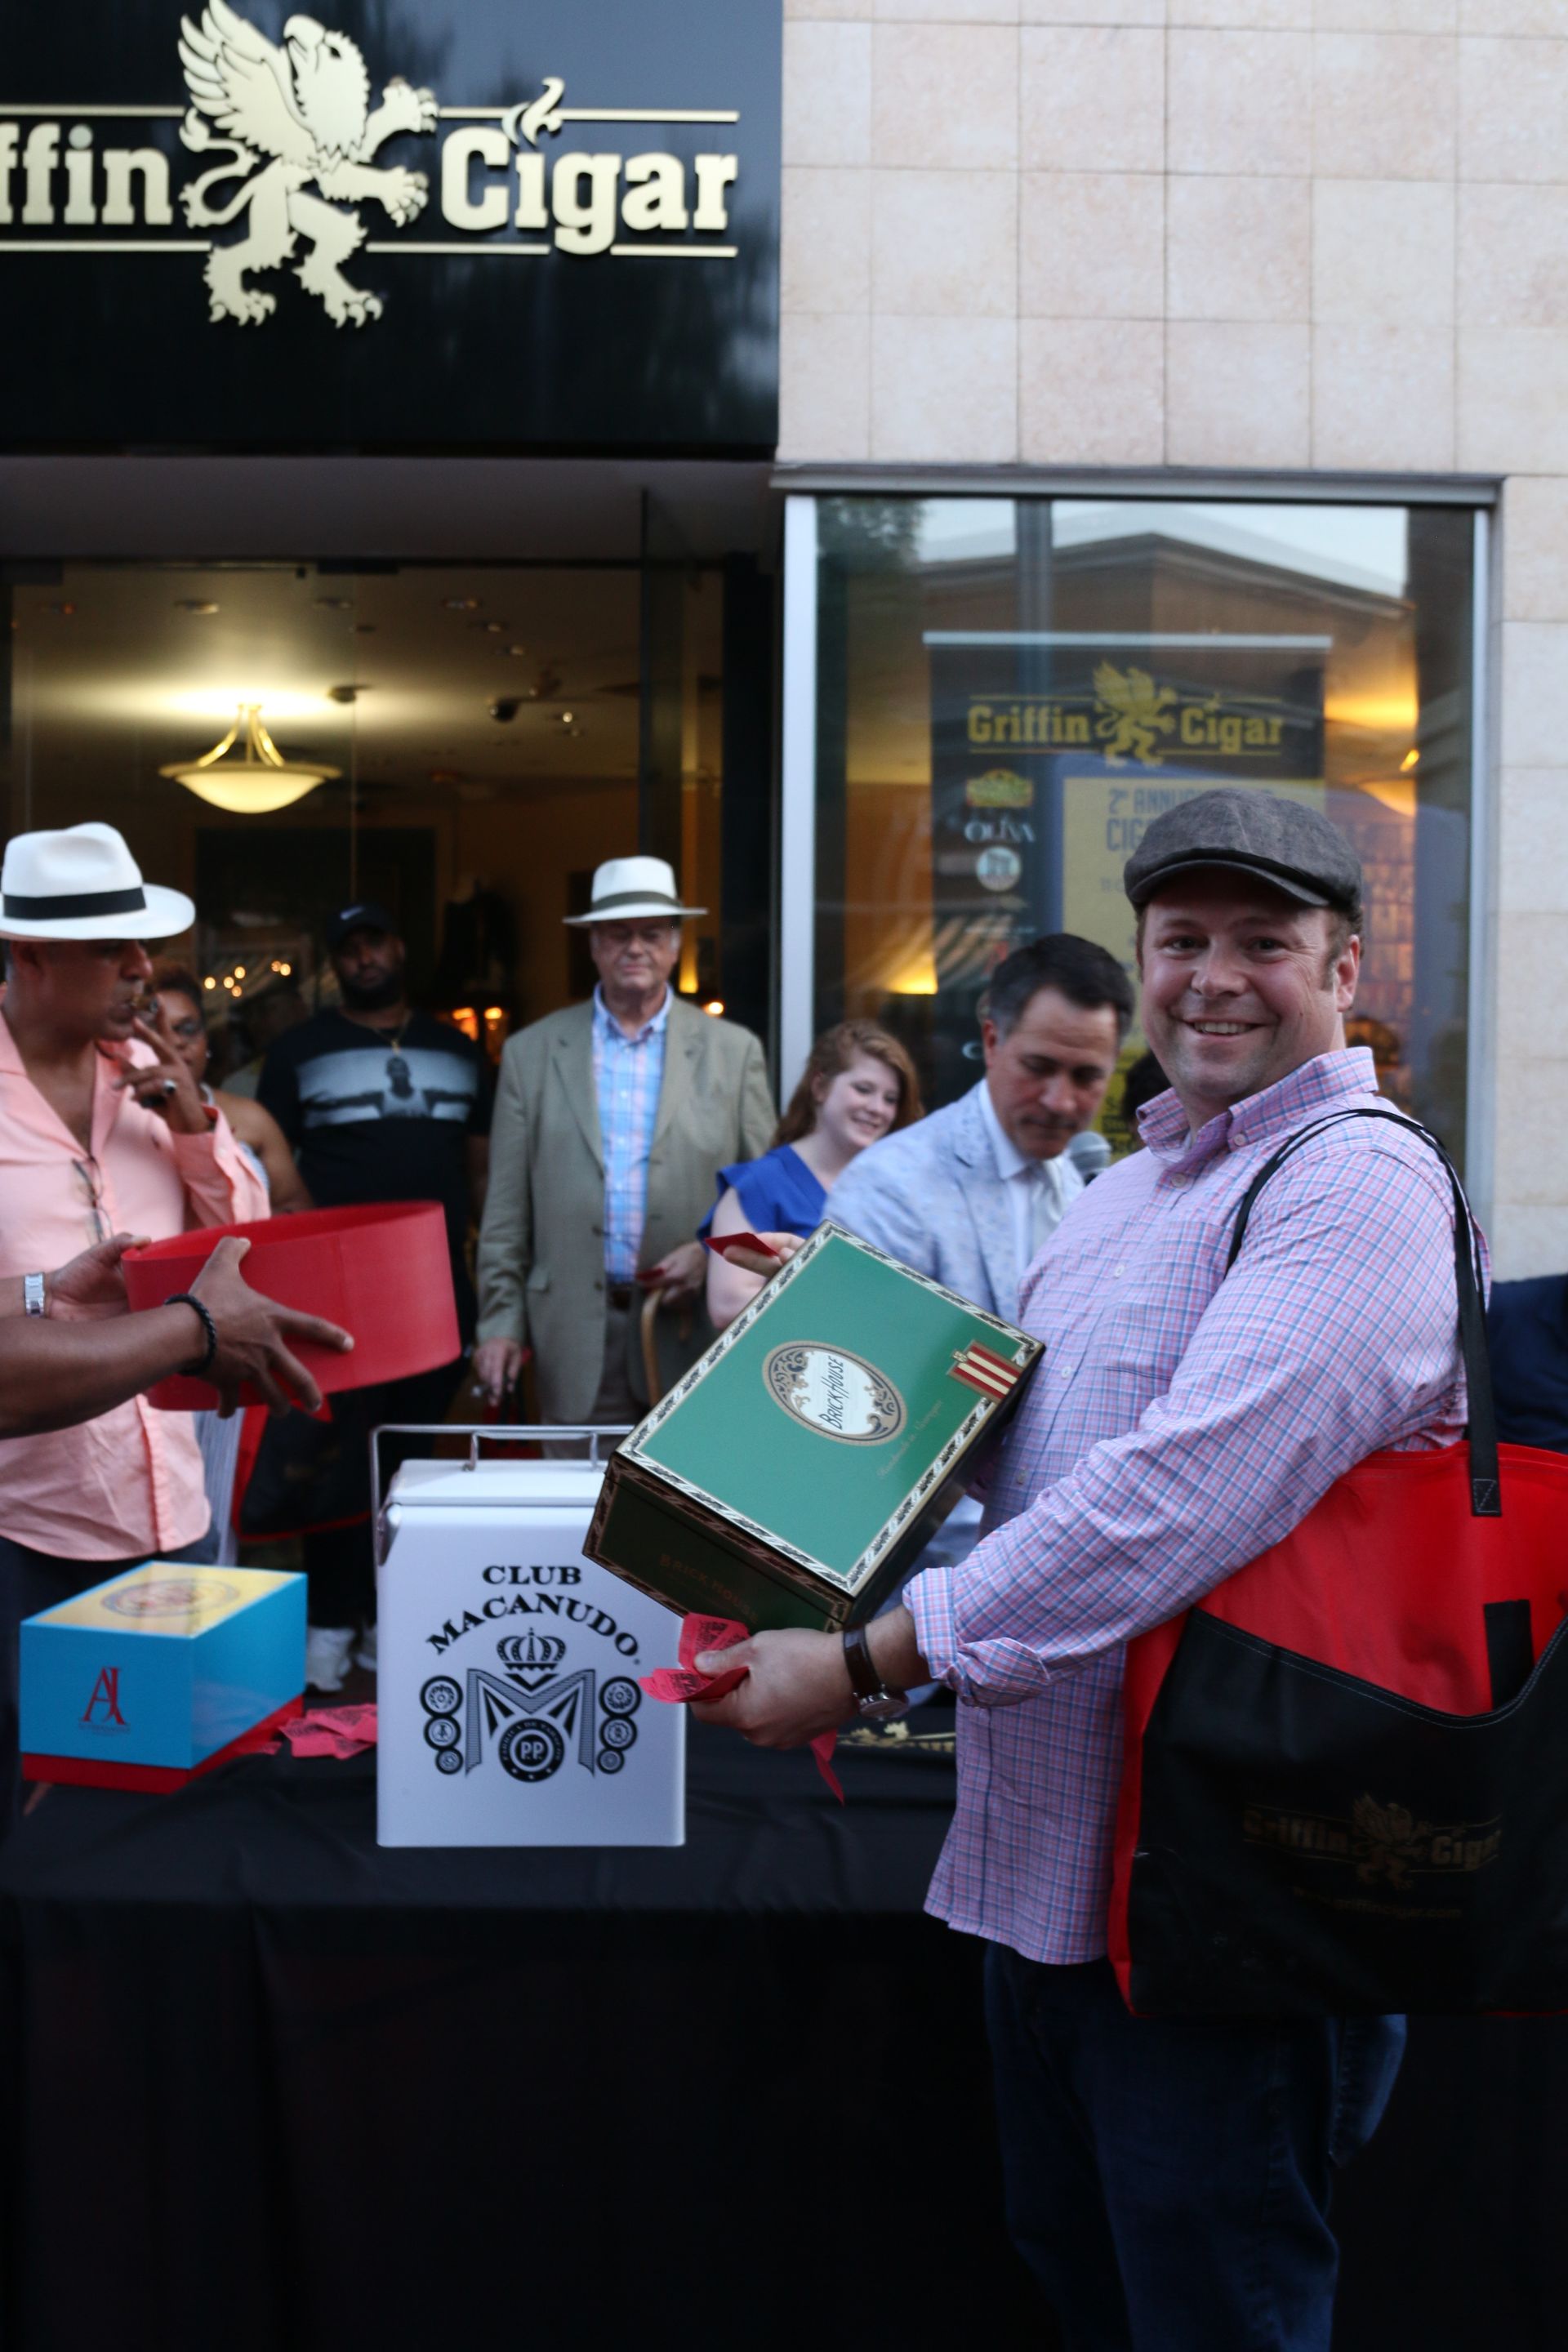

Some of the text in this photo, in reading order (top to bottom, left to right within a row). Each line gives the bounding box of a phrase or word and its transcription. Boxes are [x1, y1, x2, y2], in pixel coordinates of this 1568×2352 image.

[441, 124, 737, 255] Cigar
[967, 703, 1283, 755] Griffin Cigar
[482, 1565, 582, 1586] CLUB
[425, 1592, 639, 1657] MACANUDO
[1242, 1810, 1348, 1853] Griffin
